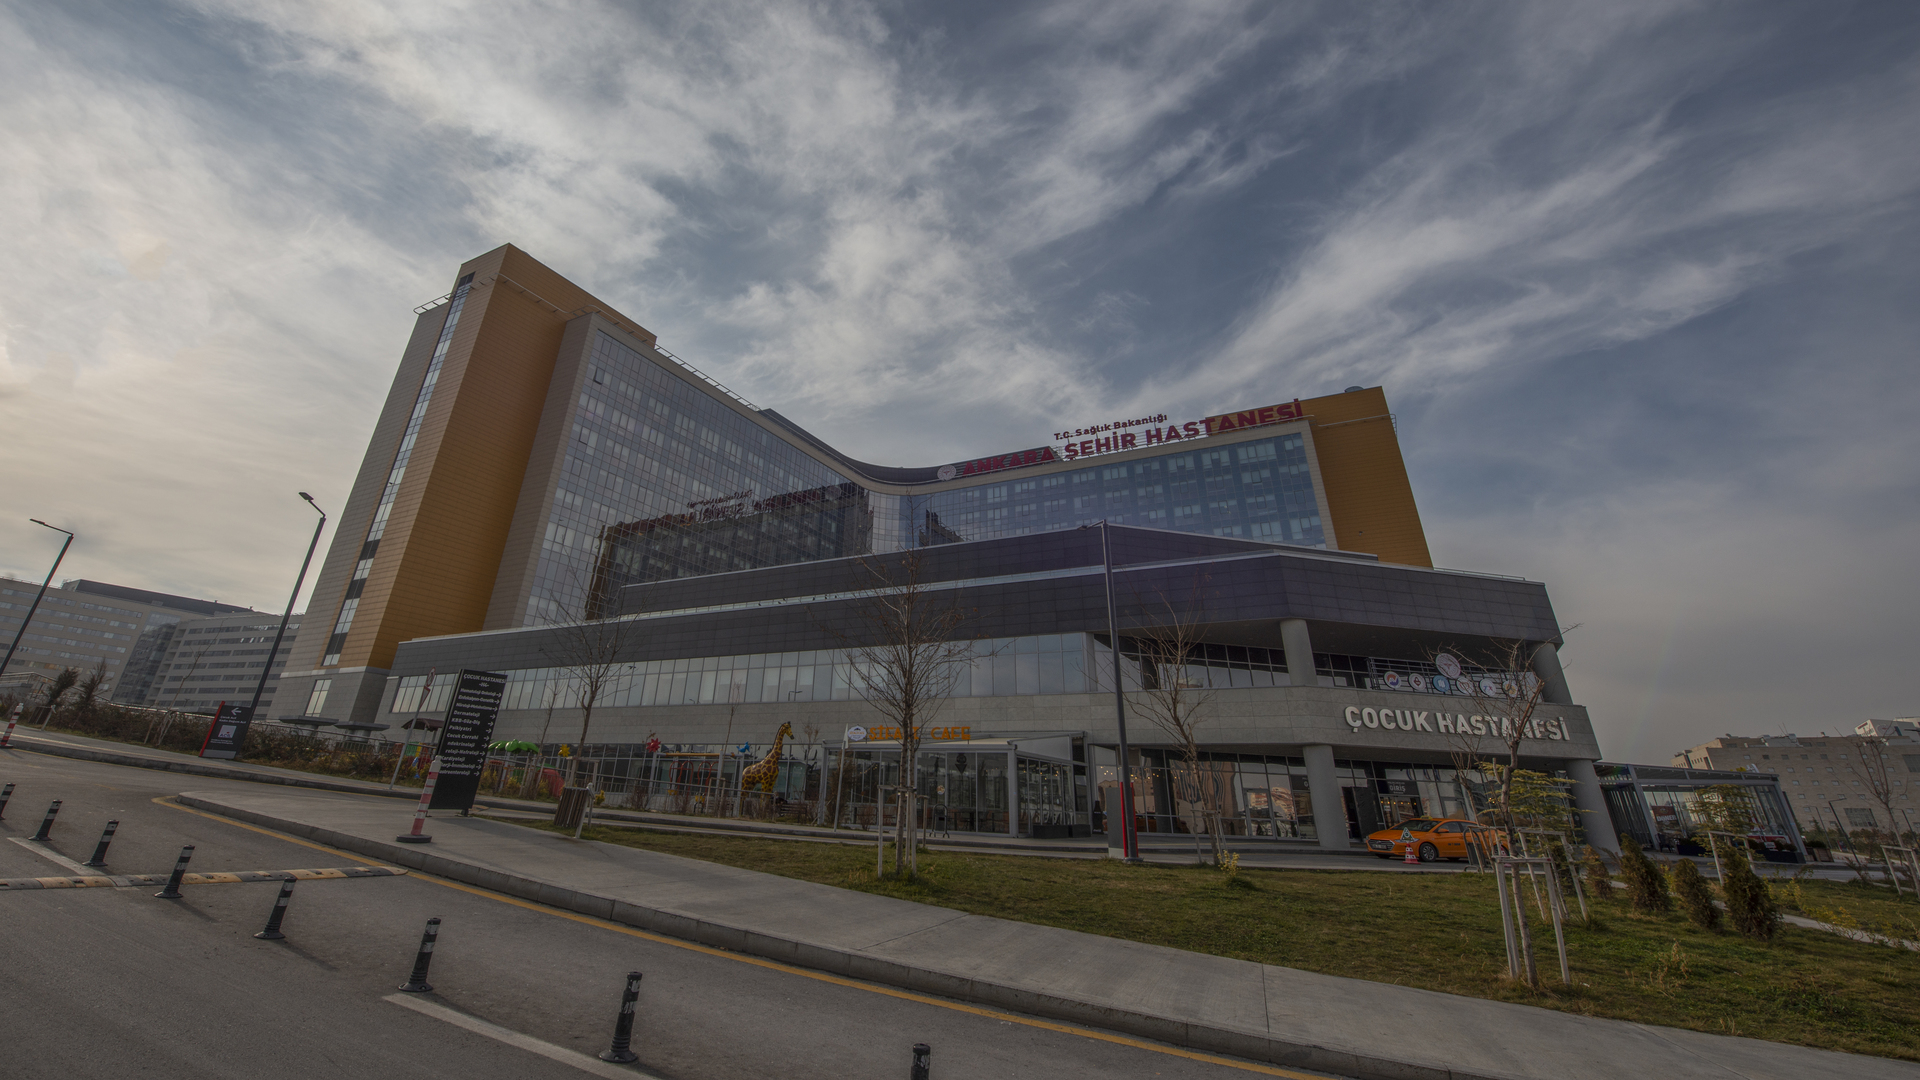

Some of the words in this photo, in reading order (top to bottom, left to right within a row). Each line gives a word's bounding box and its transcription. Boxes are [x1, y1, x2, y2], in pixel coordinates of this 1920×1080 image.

[962, 448, 1055, 476] ANKARA
[1064, 430, 1136, 460] ŞEHİR
[1146, 398, 1303, 445] HASTANESİ
[1054, 430, 1074, 440] T.C.
[1076, 424, 1111, 436] Sağlık
[1114, 414, 1168, 430] Bakanlığı
[930, 726, 971, 740] CAFE
[1344, 706, 1432, 733] ÇOCUK
[1436, 712, 1570, 741] HASTANESİ
